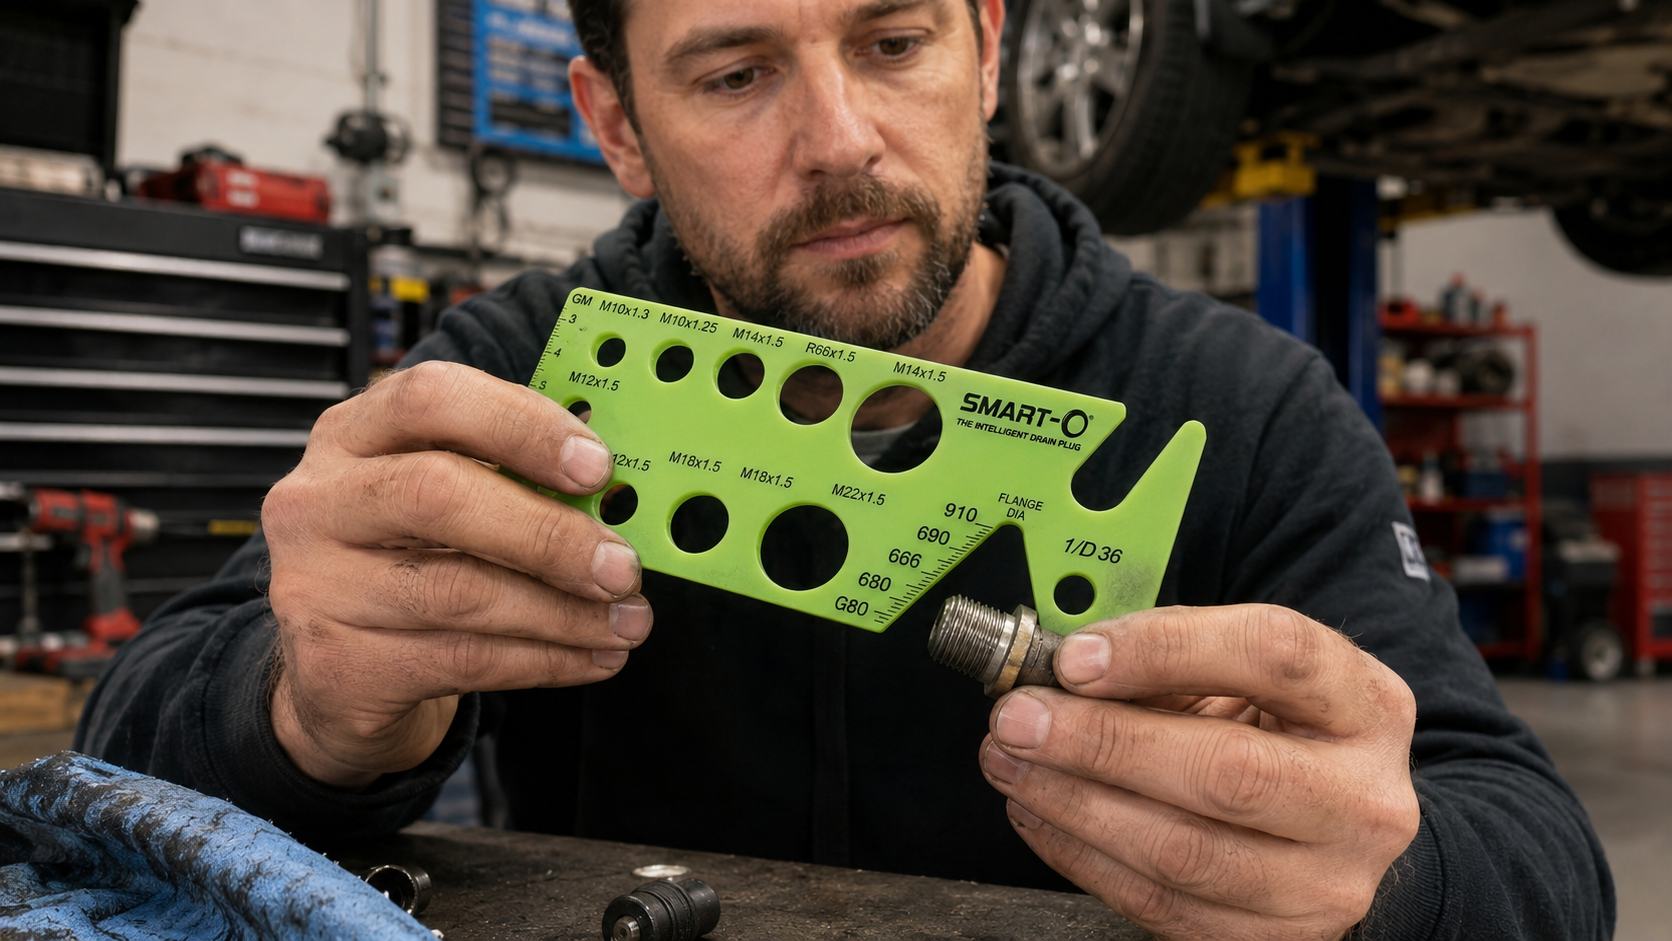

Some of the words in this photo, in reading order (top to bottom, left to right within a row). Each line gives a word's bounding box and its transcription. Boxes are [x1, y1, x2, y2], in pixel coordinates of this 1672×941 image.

[571, 293, 593, 307] GM
[599, 299, 650, 320] M10x1.3
[569, 313, 577, 324] 3
[660, 311, 719, 334] M10x1.25
[732, 327, 785, 348] M14x1.5
[554, 347, 562, 358] 4
[805, 341, 857, 363] R66x1.5
[568, 370, 621, 391] M12x1.5
[892, 361, 947, 383] M14x1.5
[956, 417, 974, 429] THE
[974, 421, 1029, 440] INTELLIGENT
[1029, 433, 1057, 446] DRAIN
[1057, 439, 1082, 452] PLUG
[612, 453, 651, 473] 12x1.5
[668, 450, 722, 473] M18x1.5
[740, 466, 794, 489] M18x1.5
[831, 483, 886, 506] M22x1.5
[998, 492, 1044, 512] FLANGE
[943, 502, 978, 523] 910
[1006, 507, 1026, 522] DIA
[916, 526, 951, 546] 690
[888, 547, 923, 569] 666
[1097, 546, 1124, 564] 36
[857, 571, 892, 593] 680
[834, 595, 869, 617] G80
